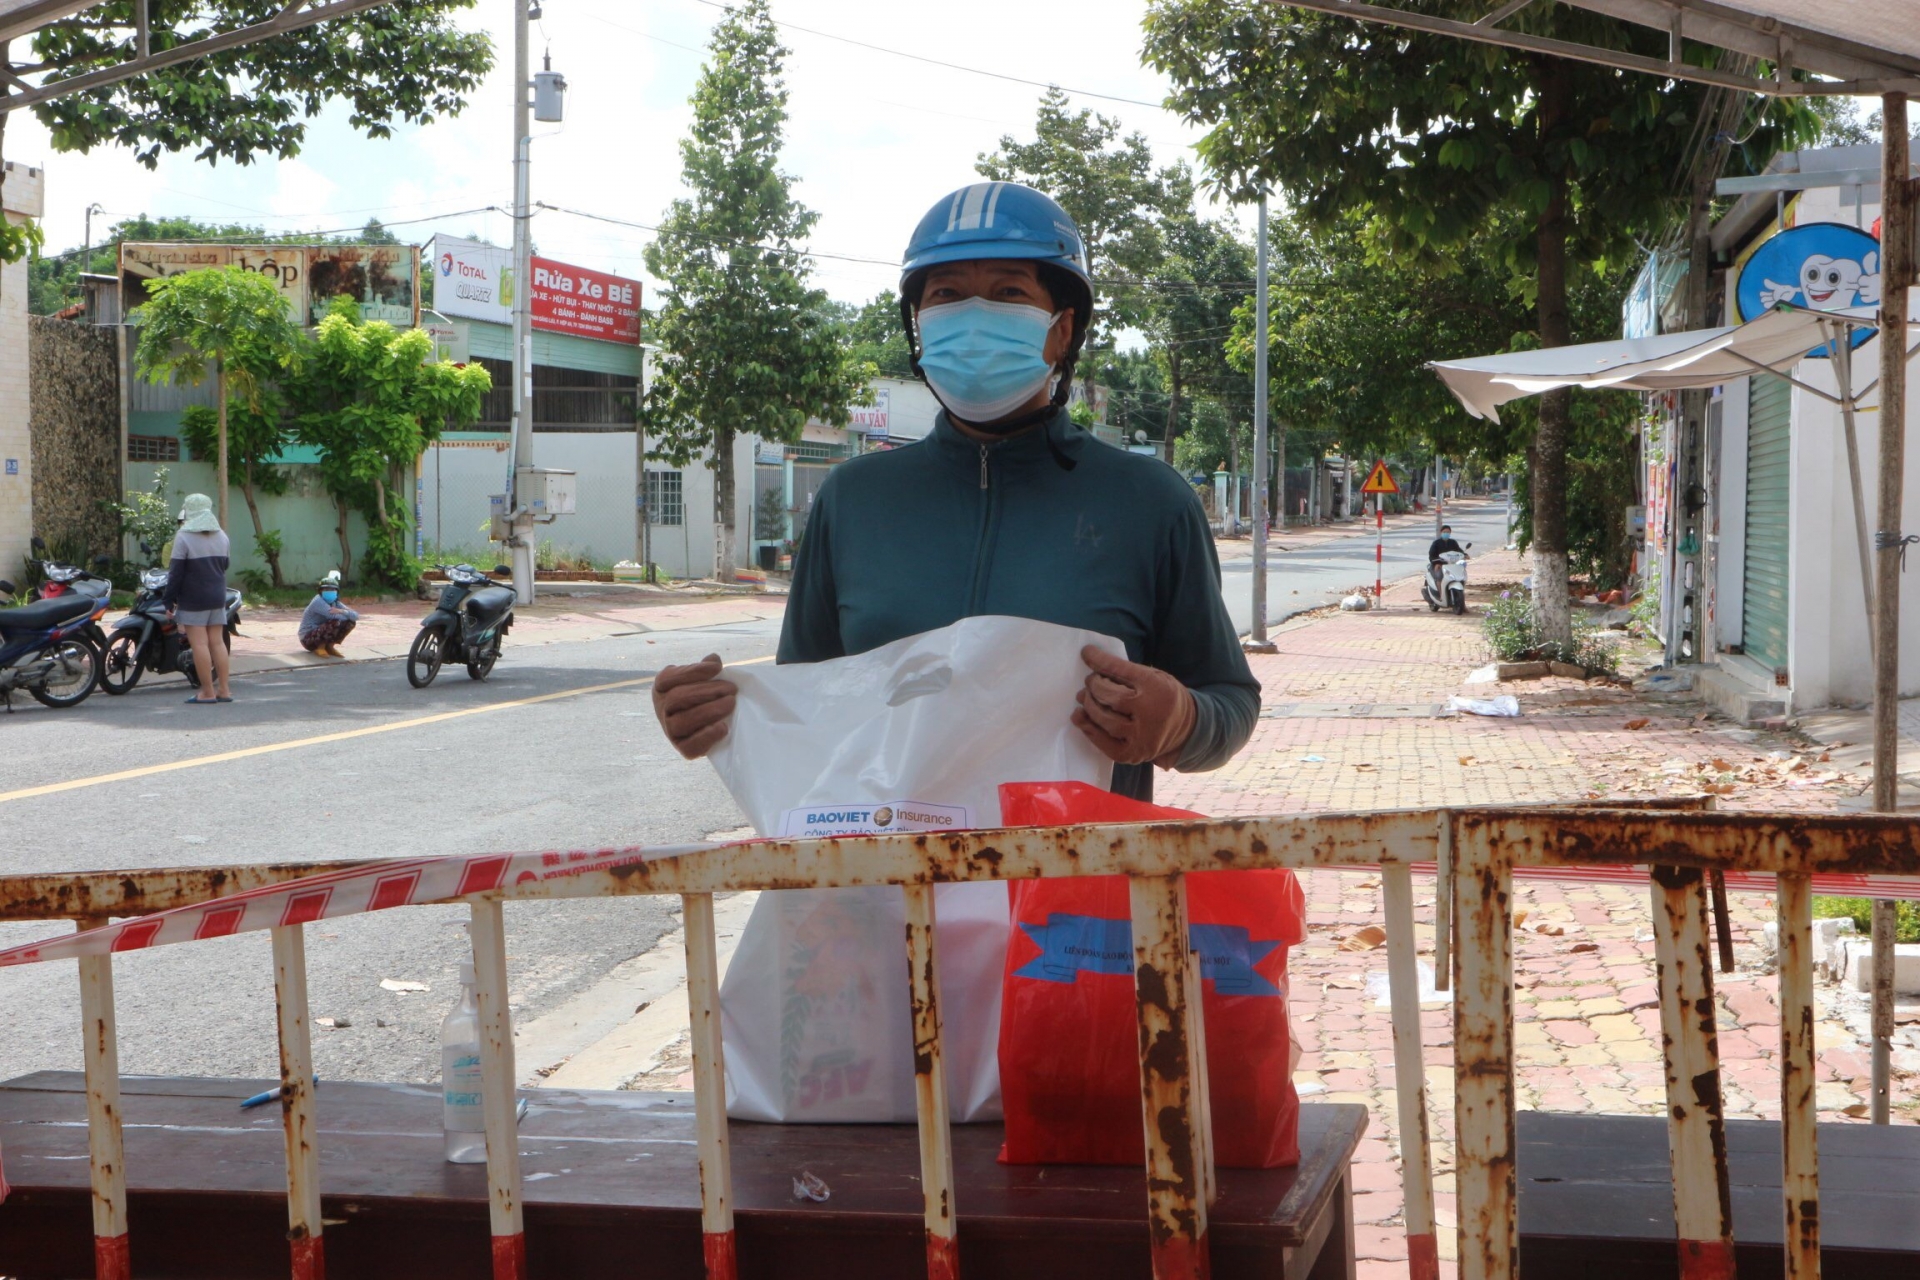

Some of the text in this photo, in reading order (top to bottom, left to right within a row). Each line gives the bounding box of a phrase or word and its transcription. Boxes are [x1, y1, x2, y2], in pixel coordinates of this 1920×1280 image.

[457, 261, 487, 280] TOTAL
[456, 281, 492, 303] QUARTZ
[534, 267, 633, 305] Rửa Xe BÉ
[539, 291, 548, 301] XE
[552, 294, 566, 305] HÚT
[582, 301, 597, 311] THAY
[552, 307, 557, 315] 4
[558, 307, 576, 319] BÁNH
[598, 315, 614, 326] BASS
[868, 408, 887, 428] VĂN
[806, 808, 953, 826] BAOVIET Insurance
[1117, 951, 1134, 962] ĐỘN
